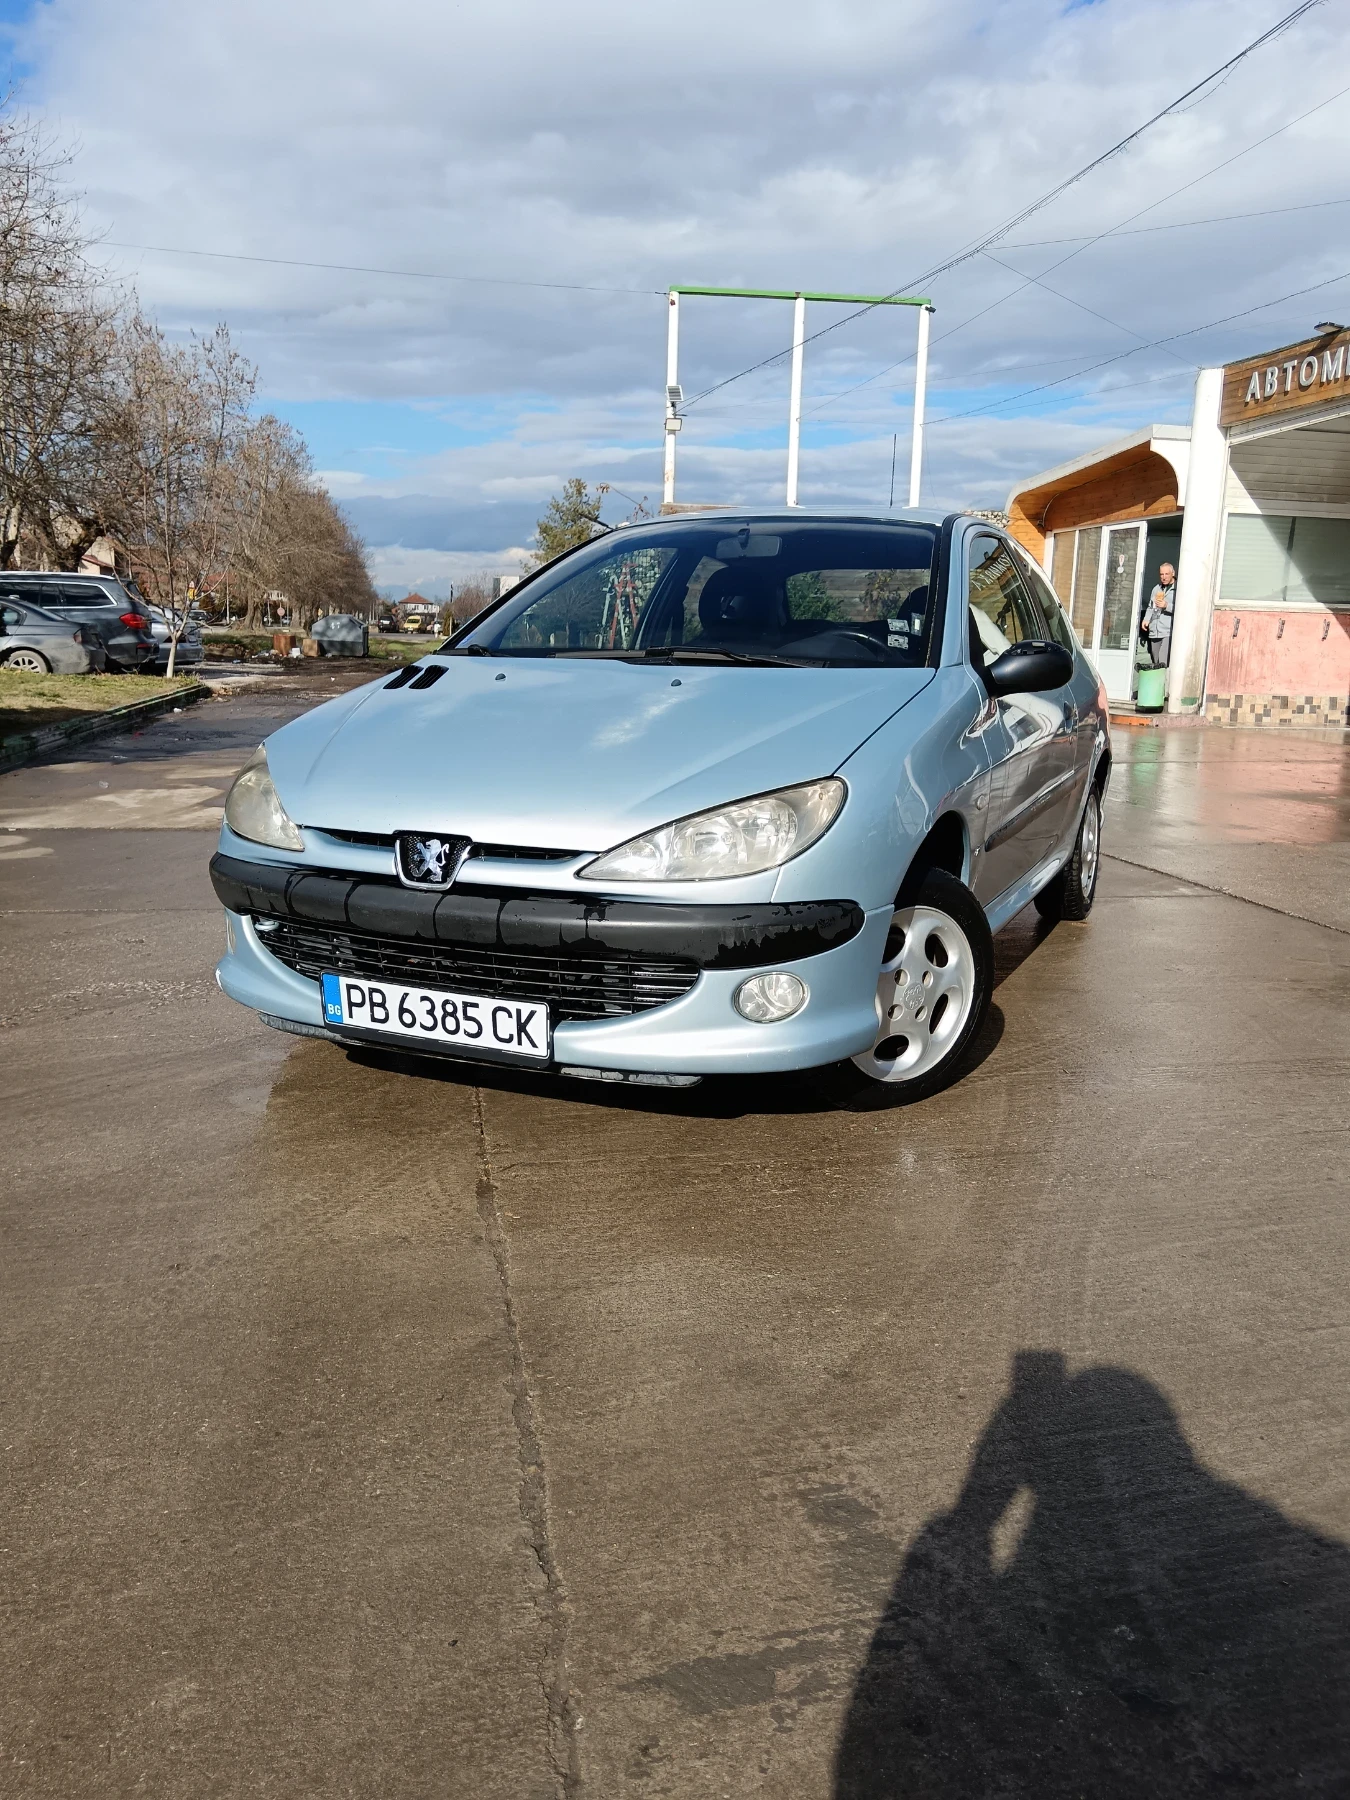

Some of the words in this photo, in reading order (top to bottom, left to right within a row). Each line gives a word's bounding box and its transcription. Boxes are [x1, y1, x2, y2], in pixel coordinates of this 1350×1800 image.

[327, 1003, 342, 1016] BG
[346, 983, 389, 1024] PB
[398, 992, 483, 1039] 6385
[491, 1006, 539, 1049] CK
